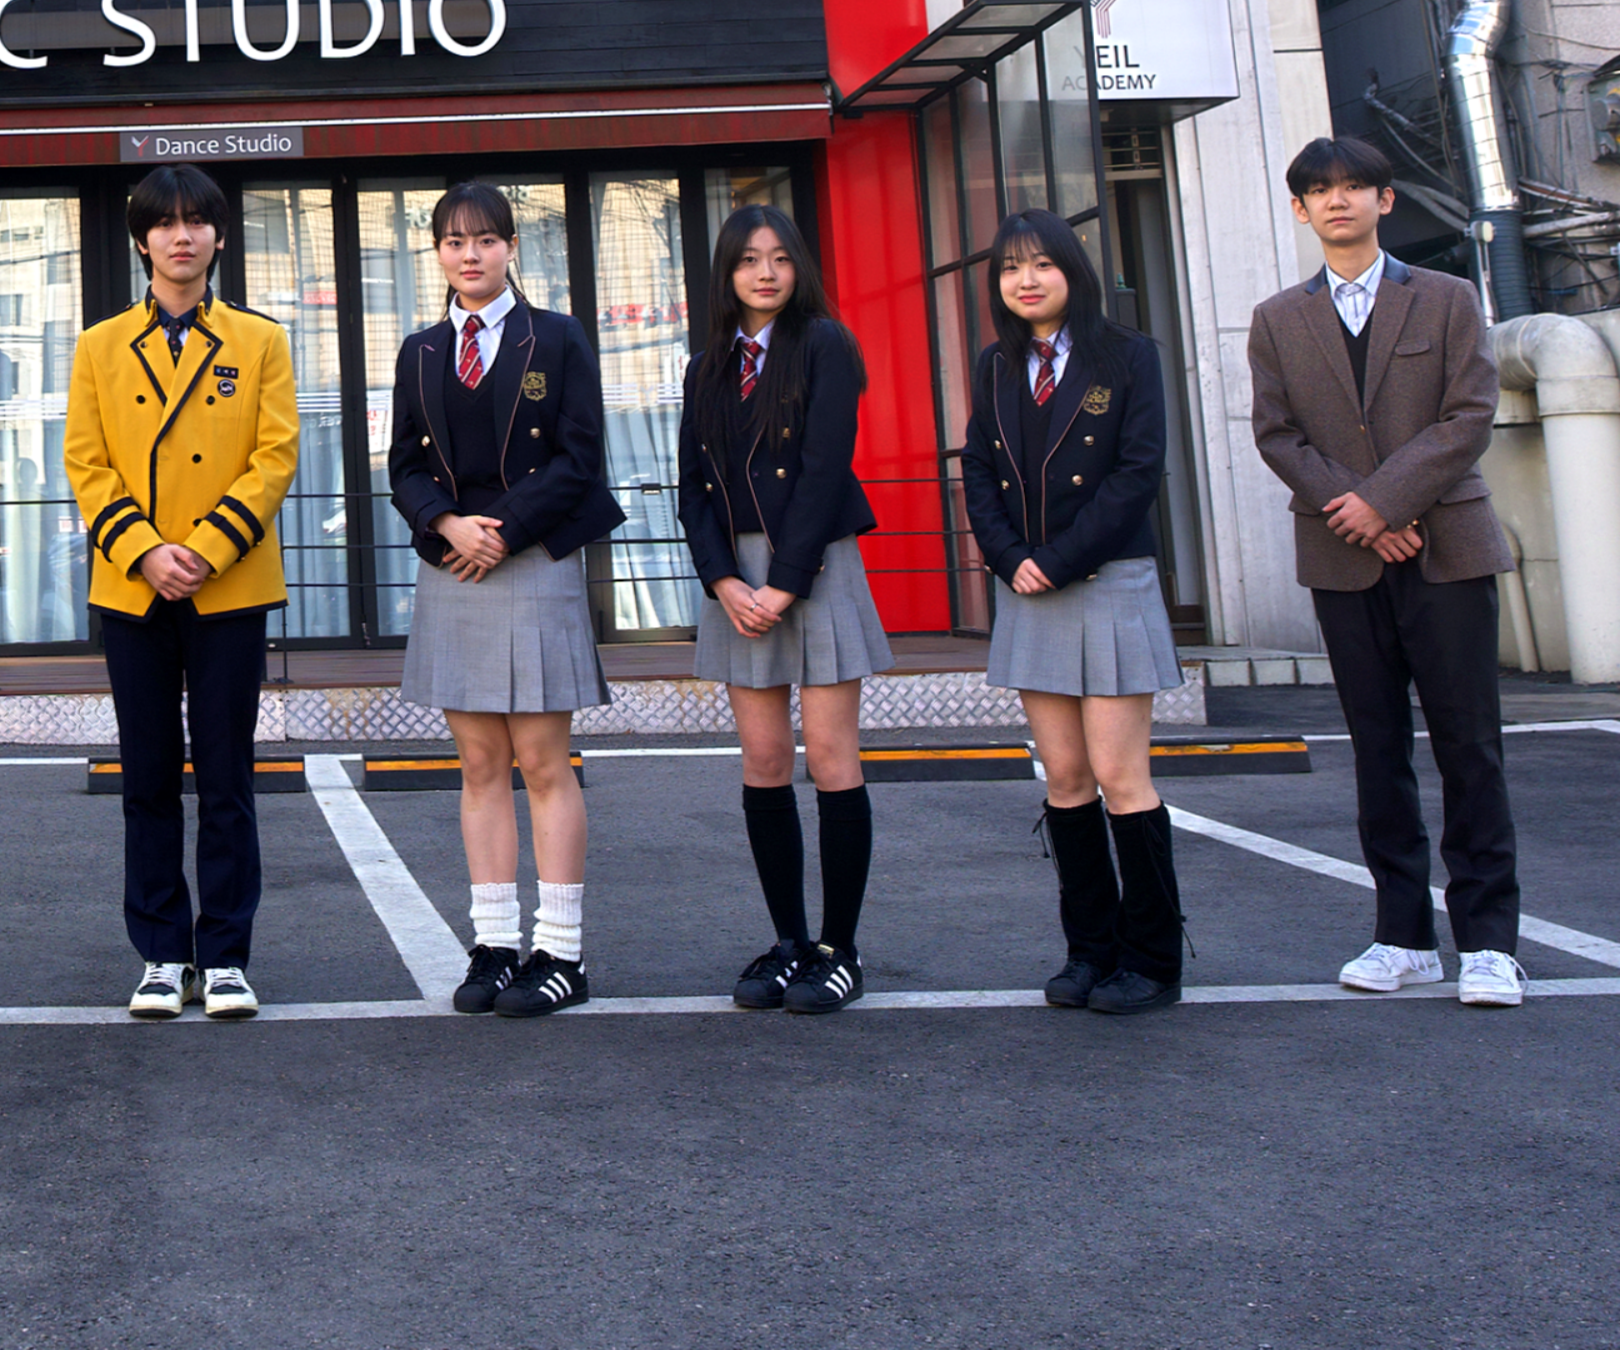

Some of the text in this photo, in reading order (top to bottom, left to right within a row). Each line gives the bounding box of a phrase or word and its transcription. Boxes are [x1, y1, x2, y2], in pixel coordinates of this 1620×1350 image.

[101, 0, 507, 67] STUDIO
[155, 137, 219, 156] Dance
[224, 133, 292, 154] Studio
